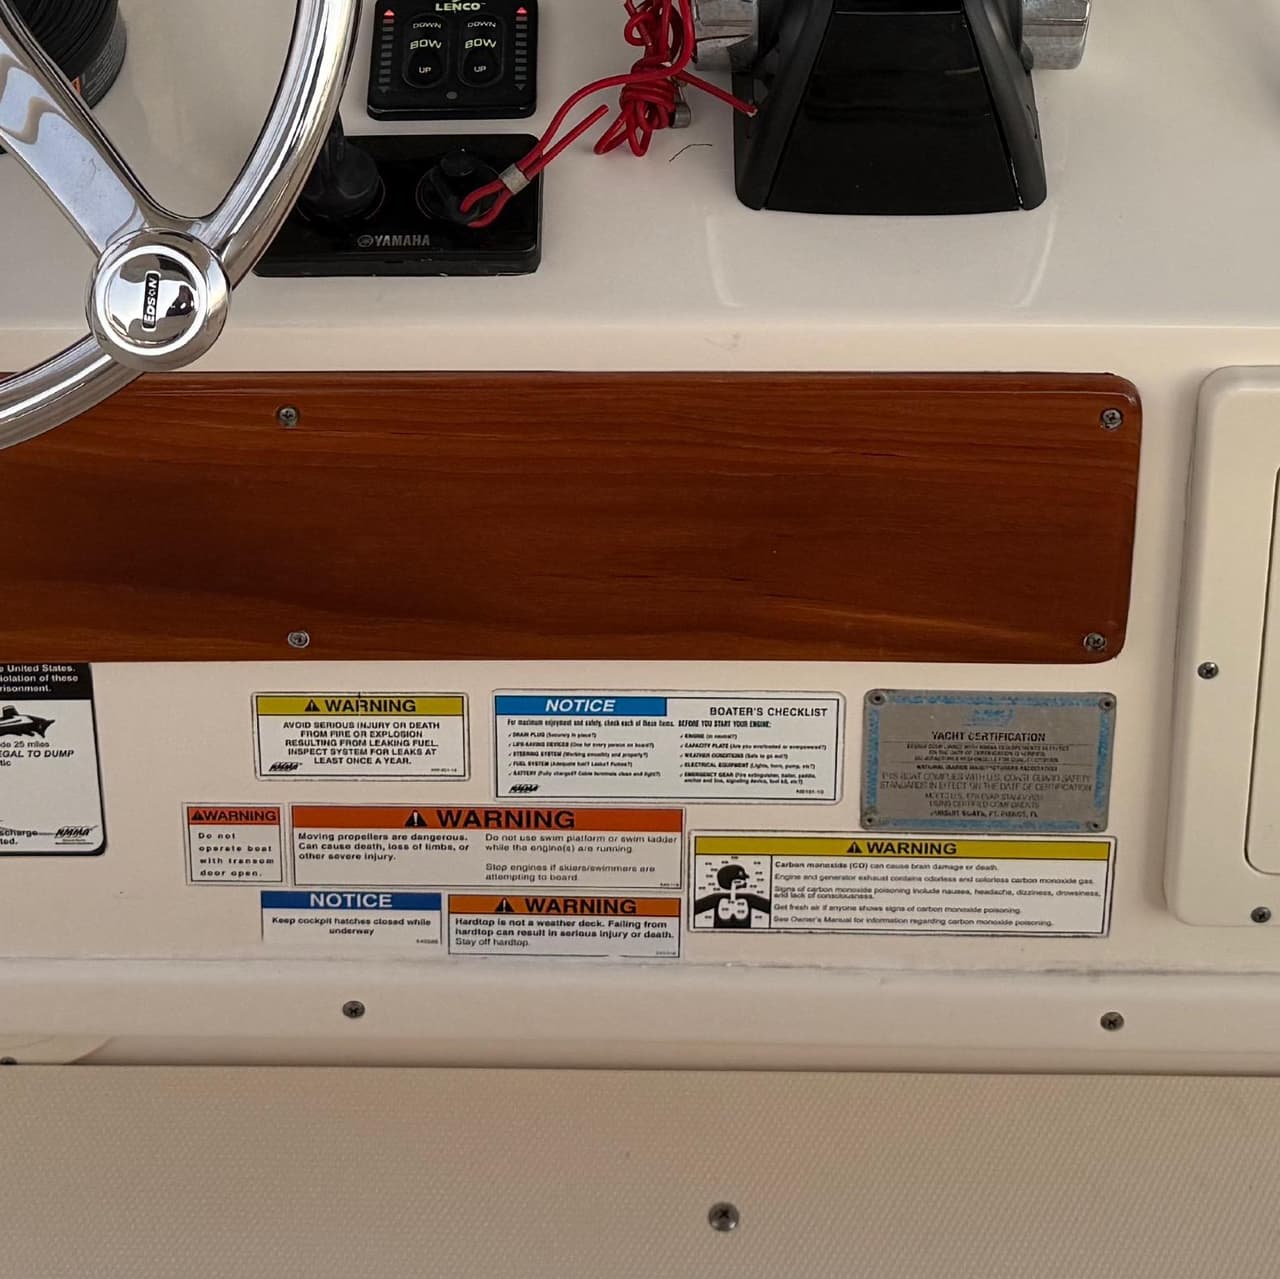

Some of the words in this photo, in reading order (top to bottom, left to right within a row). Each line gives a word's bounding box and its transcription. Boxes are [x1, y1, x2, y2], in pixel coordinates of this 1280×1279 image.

[435, 2, 481, 11] LENCO
[410, 39, 442, 50] BOW
[464, 38, 497, 49] BOW
[374, 234, 431, 247] YAMAHA
[144, 277, 158, 325] EDSON
[6, 665, 40, 673] United
[325, 699, 416, 712] WARNING
[545, 699, 617, 712] NOTICE
[709, 707, 763, 716] BOATER'S
[767, 707, 828, 717] CHECKLIST
[300, 730, 328, 738] FROM
[329, 730, 351, 738] FIRE
[352, 730, 368, 738] OR
[369, 730, 423, 738] EXPLOSION
[284, 739, 338, 747] RESULTING
[339, 739, 367, 747] FROM
[368, 739, 411, 747] LEAKING
[28, 750, 42, 758] TO
[43, 750, 75, 758] DUMP
[287, 748, 327, 756] INSPECT
[330, 748, 368, 756] SYSTEM
[369, 748, 390, 756] FOR
[391, 748, 423, 756] LEAKS
[424, 748, 436, 756] AT
[313, 757, 343, 765] LEAST
[346, 757, 373, 765] ONCE
[374, 757, 382, 765] A
[203, 810, 277, 821] WARNING
[437, 810, 575, 829] WARNING
[298, 833, 335, 842] Moving
[337, 834, 389, 843] propellers
[298, 842, 319, 850] Can
[387, 843, 410, 851] loss
[412, 843, 423, 851] of
[866, 842, 957, 855] WARNING
[309, 893, 392, 909] NOTICE
[525, 898, 637, 914] WARNING
[455, 918, 495, 928] Hardtop
[497, 919, 507, 927] is
[508, 919, 526, 927] not
[536, 919, 576, 928] weather
[607, 920, 642, 930] Falling
[643, 920, 668, 929] from
[454, 928, 494, 938] hardtop
[516, 929, 546, 937] result
[560, 930, 597, 938] serious
[599, 930, 629, 940] injury
